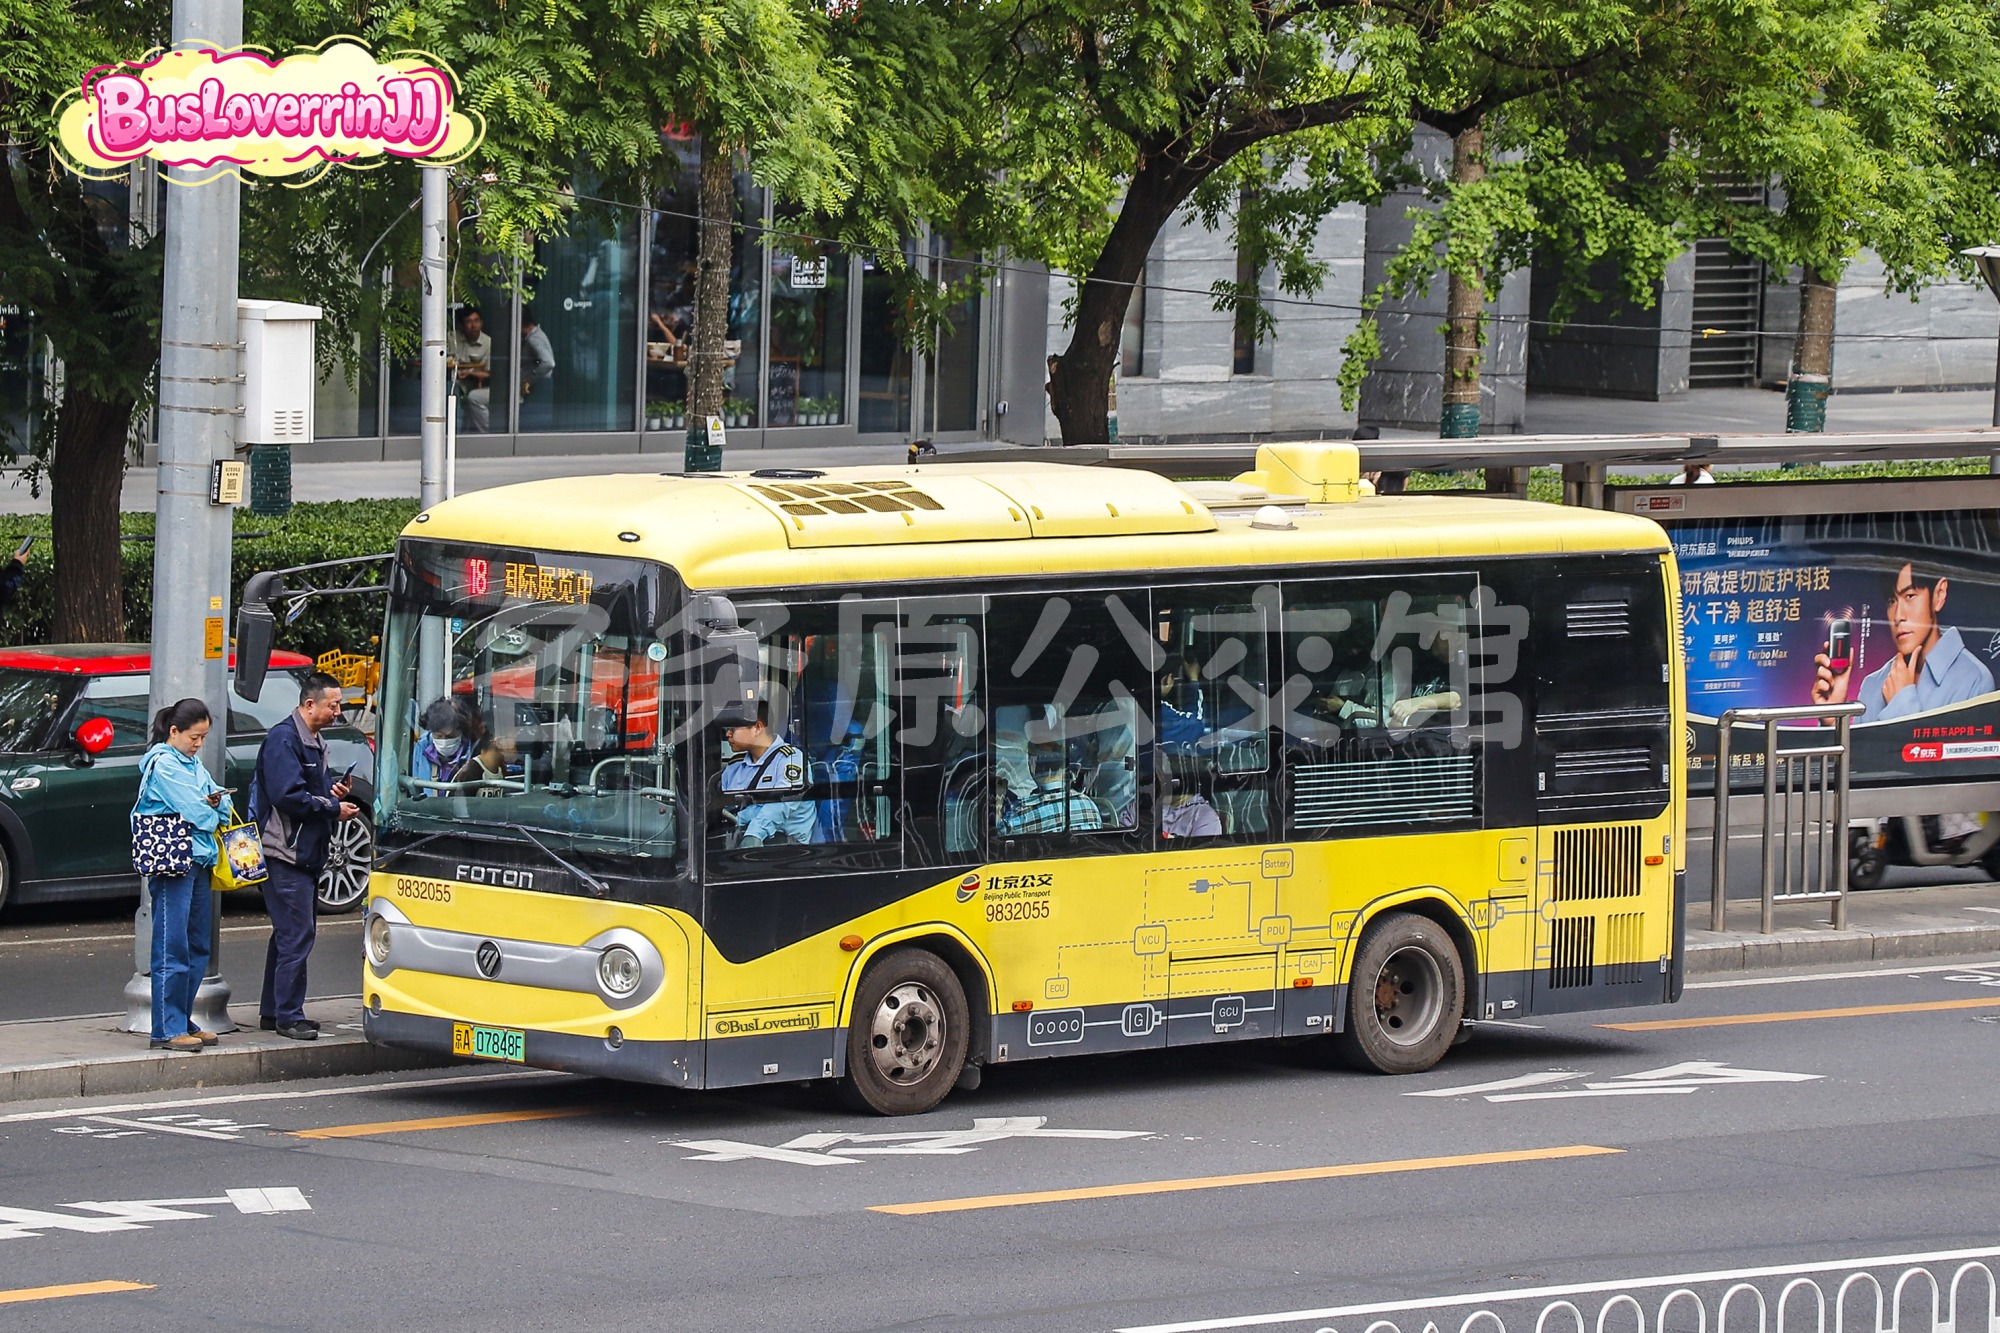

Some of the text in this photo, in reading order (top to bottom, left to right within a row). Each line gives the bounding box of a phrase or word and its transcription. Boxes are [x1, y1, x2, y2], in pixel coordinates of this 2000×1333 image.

[1727, 537, 1754, 545] PHILIPS
[1679, 543, 1716, 556] 京东新品
[470, 559, 488, 594] 18
[1680, 567, 1831, 595] 研微提切旋护科技
[1706, 600, 1741, 625] 干净
[1747, 598, 1801, 623] 超舒适
[1748, 649, 1788, 660] Turbo Max
[1264, 859, 1291, 869] Battery
[456, 864, 534, 889] FOTON
[985, 873, 1053, 891] 北京公交
[397, 878, 451, 903] 9832055
[984, 889, 1051, 901] Beijing Public Transport
[986, 900, 1050, 923] 9832055
[1477, 909, 1488, 922] M
[1266, 925, 1285, 936] PDU
[1336, 920, 1356, 931] MC
[1141, 934, 1160, 945] VCU
[1303, 959, 1318, 969] CAN
[1050, 983, 1065, 993] ECU
[1219, 1007, 1239, 1018] GCU
[1134, 1013, 1144, 1027] G
[476, 1031, 523, 1057] 07848F
